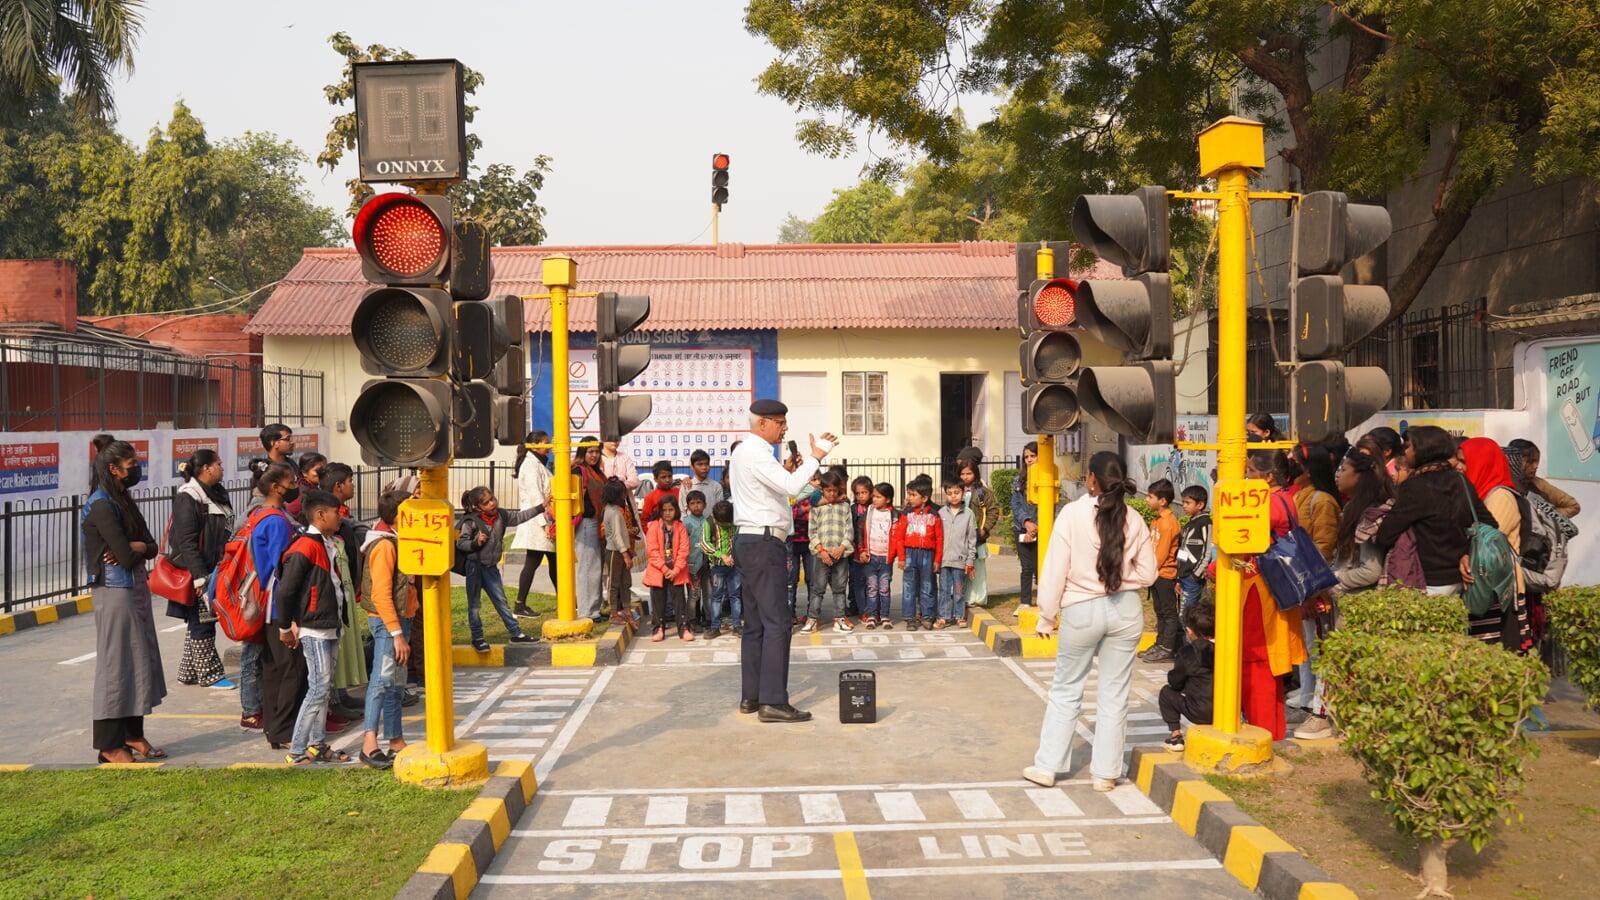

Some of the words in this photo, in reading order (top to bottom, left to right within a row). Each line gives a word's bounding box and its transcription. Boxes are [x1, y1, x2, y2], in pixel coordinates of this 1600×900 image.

[376, 160, 447, 174] ONNYX
[618, 332, 649, 344] ROAD
[653, 332, 690, 344] SIGNS
[1549, 348, 1578, 373] FRIEND
[1560, 365, 1574, 379] OFF
[1557, 377, 1579, 398] ROAD
[1575, 387, 1591, 404] BUT
[1220, 488, 1269, 508] N-157
[400, 510, 451, 531] N-157
[1235, 528, 1250, 544] 3
[412, 548, 425, 567] 7
[536, 834, 814, 872] STOP
[918, 832, 1094, 860] LINE
